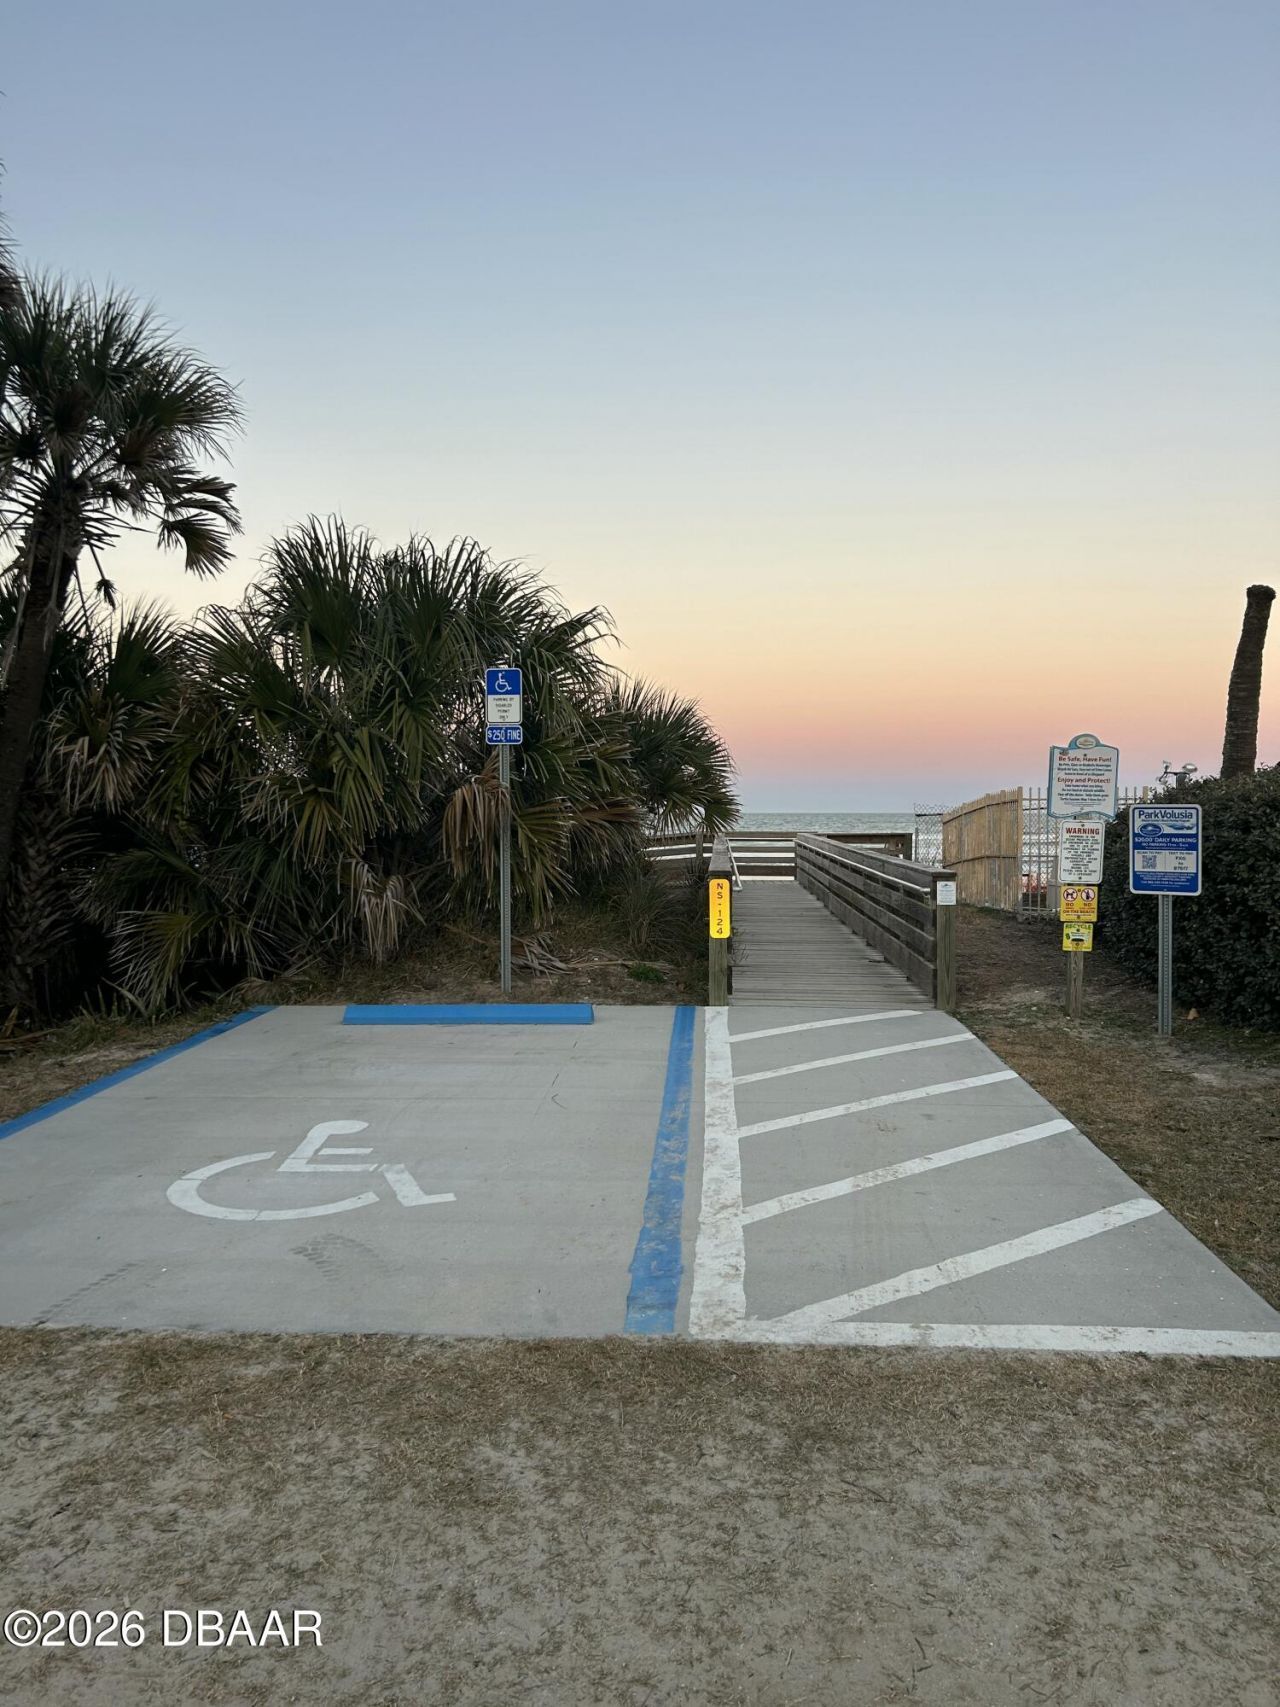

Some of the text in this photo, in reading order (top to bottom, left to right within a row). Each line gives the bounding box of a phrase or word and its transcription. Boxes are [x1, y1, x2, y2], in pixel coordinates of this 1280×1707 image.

[487, 729, 520, 741] $250 FINE
[1066, 827, 1100, 835] WARNING
